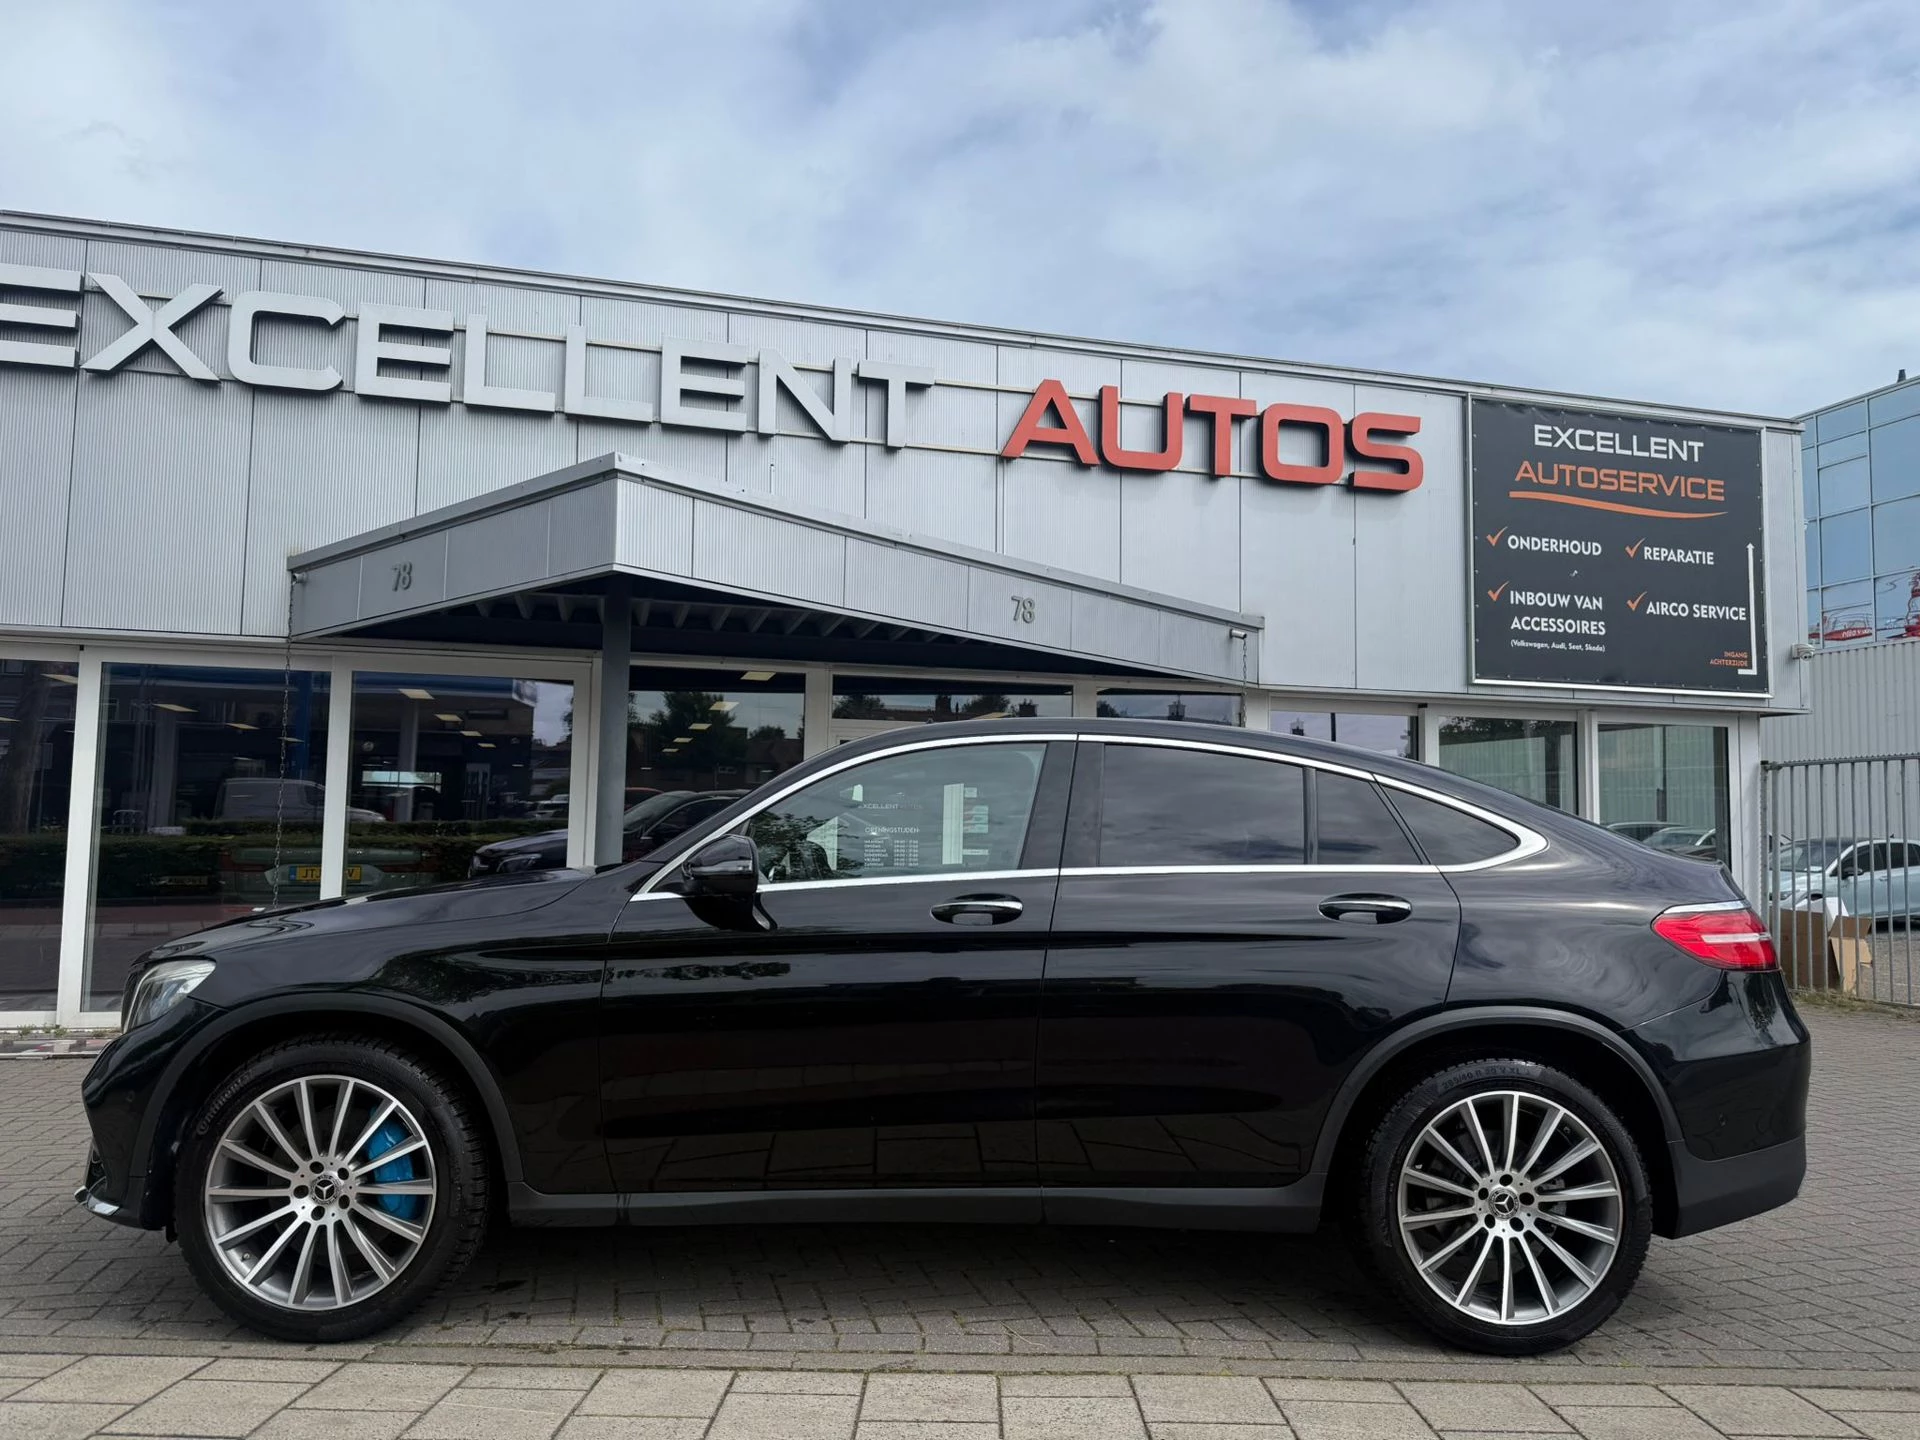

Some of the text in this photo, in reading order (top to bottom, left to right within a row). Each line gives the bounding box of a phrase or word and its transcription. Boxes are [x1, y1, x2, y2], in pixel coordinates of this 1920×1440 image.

[0, 263, 1424, 493] EXCELLENT AUTOS
[1534, 424, 1704, 462] EXCELLENT
[1514, 460, 1725, 501] AUTOSERVICE
[1507, 535, 1602, 556] ONDERHOUD
[1643, 546, 1714, 565] REPARATIE
[391, 561, 413, 592] 78
[1011, 596, 1035, 623] 78
[1510, 590, 1603, 611] INBOUW VAN
[1646, 601, 1747, 621] AIRCO SERVICE
[1511, 616, 1606, 636] ACCESSOIRES
[1511, 639, 1550, 651] (Volkswagen,
[1551, 641, 1567, 651] Audi,
